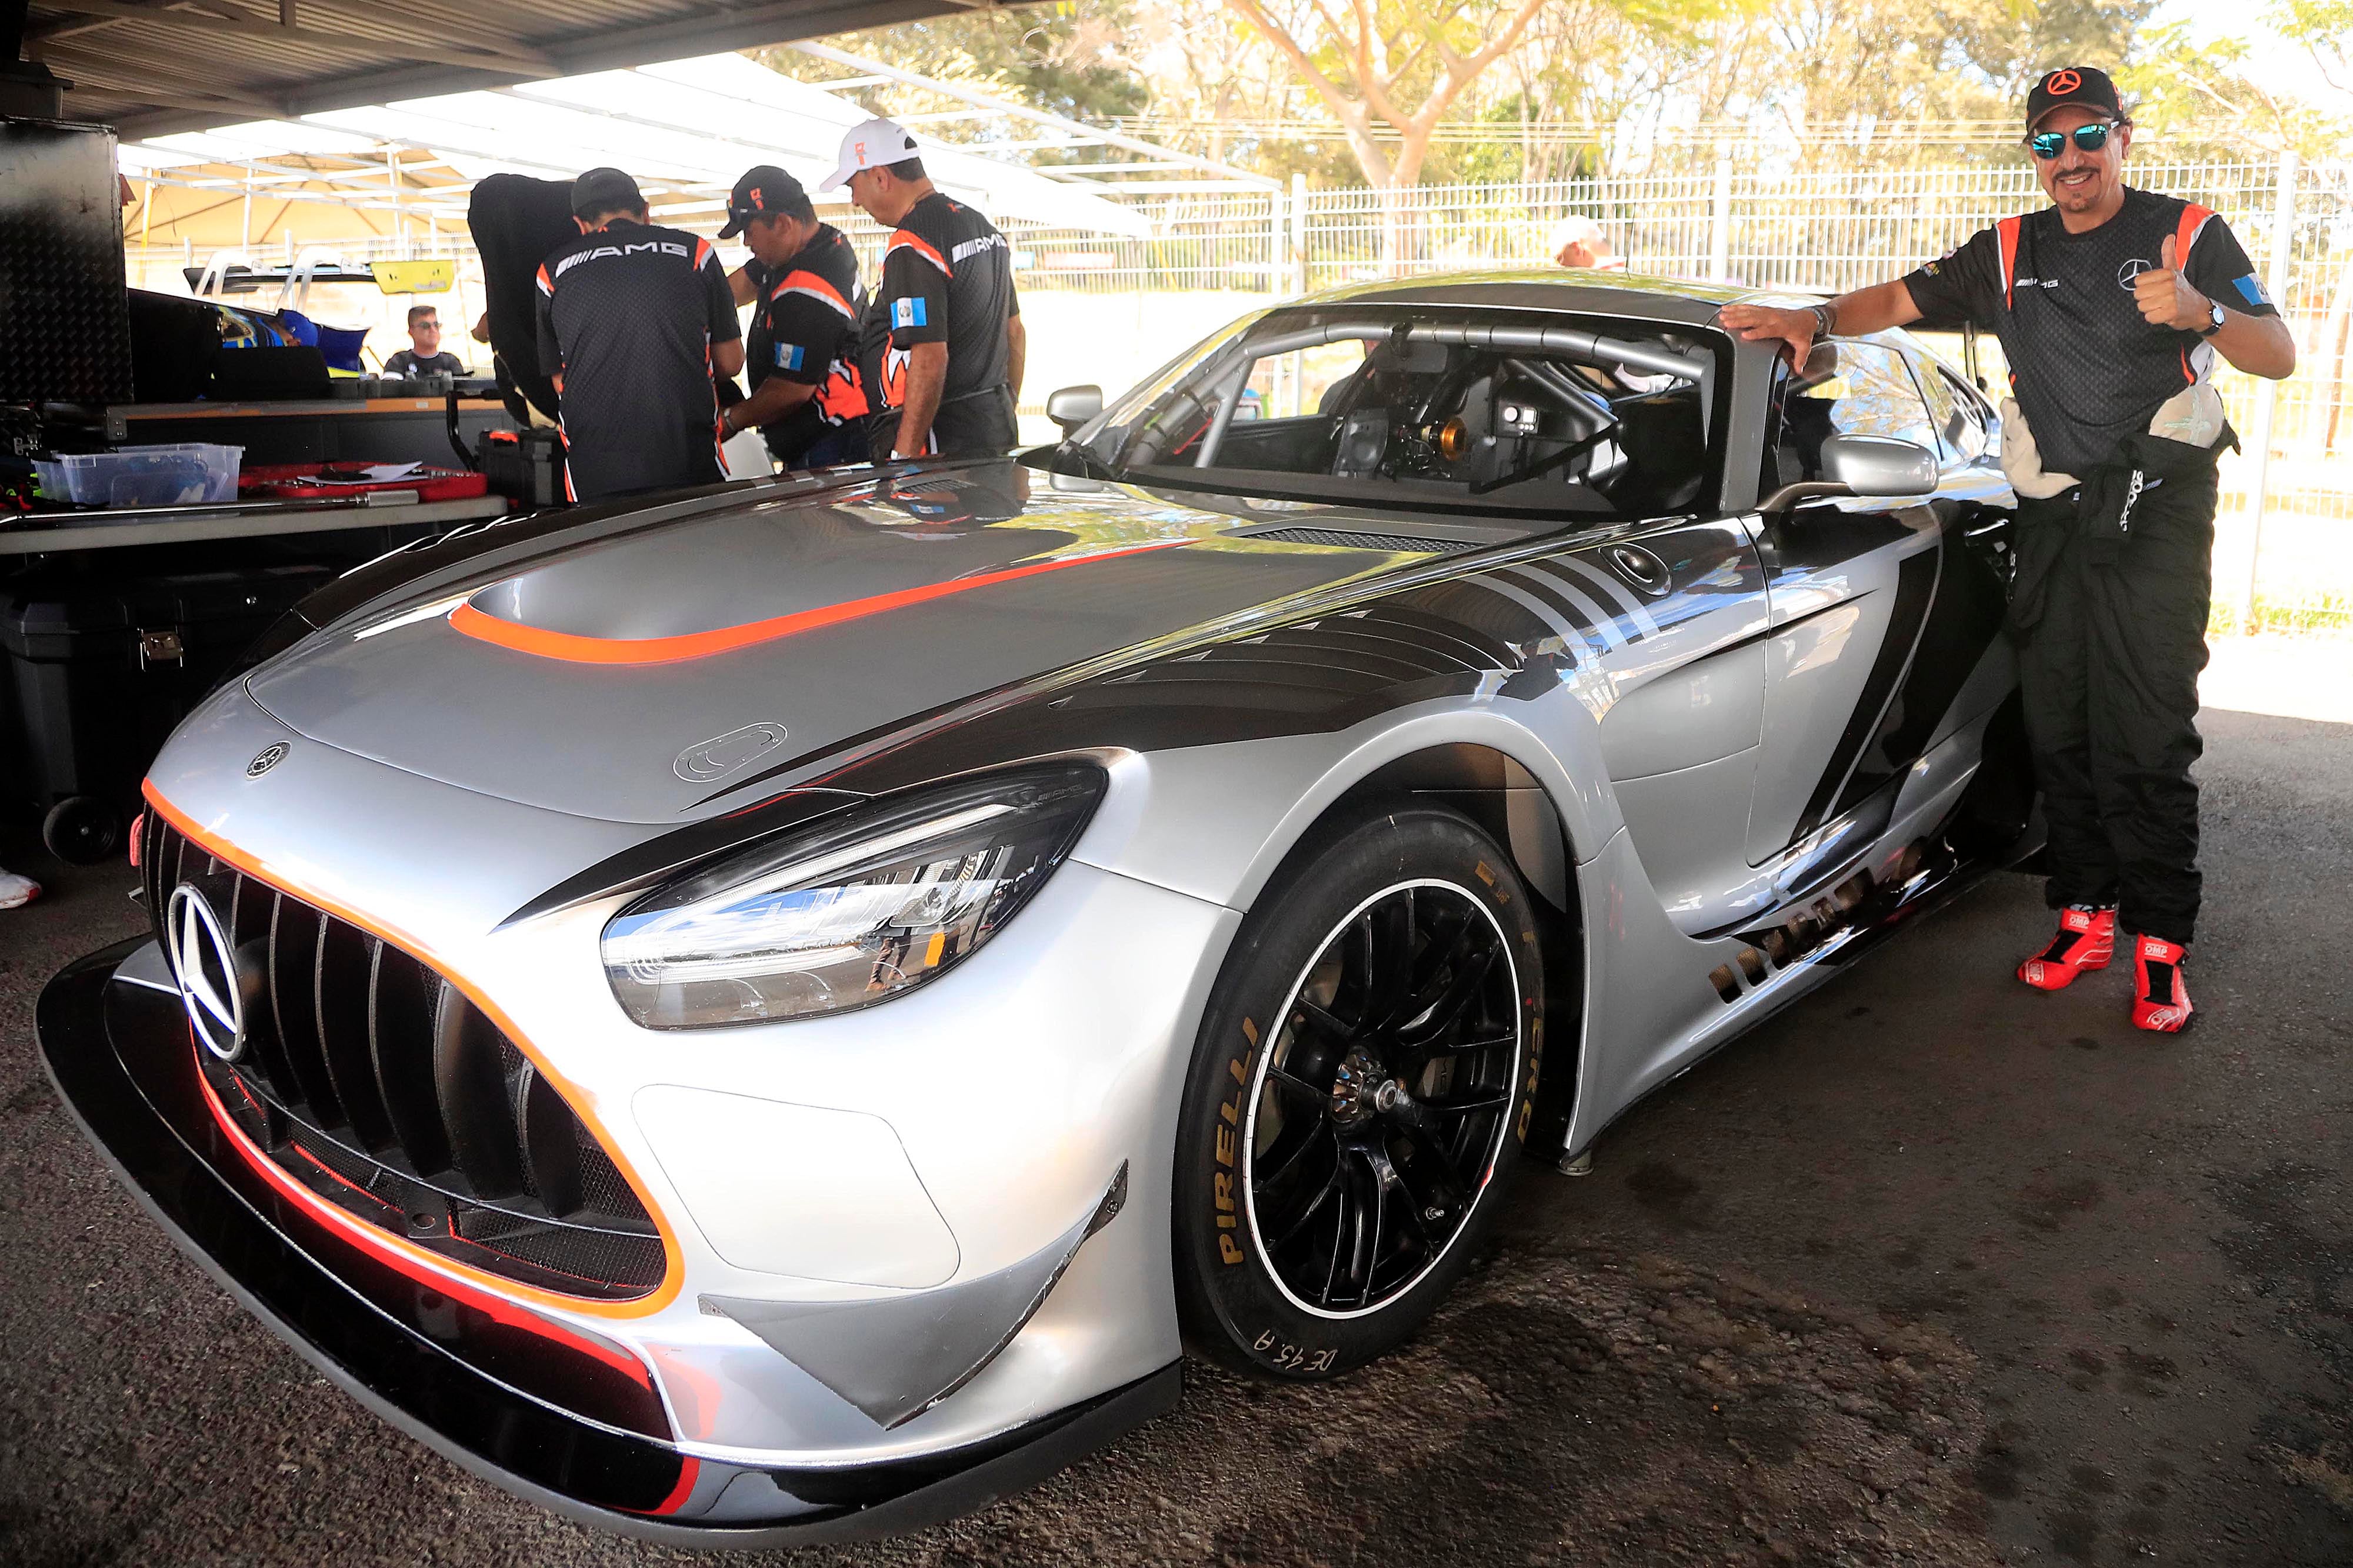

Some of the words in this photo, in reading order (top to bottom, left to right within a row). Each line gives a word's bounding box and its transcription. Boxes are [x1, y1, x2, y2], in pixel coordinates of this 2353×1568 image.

[590, 242, 688, 260] AMG
[2069, 916, 2090, 928] OMP
[2145, 945, 2168, 956] OMP
[1214, 1016, 1258, 1264] PIRELLI
